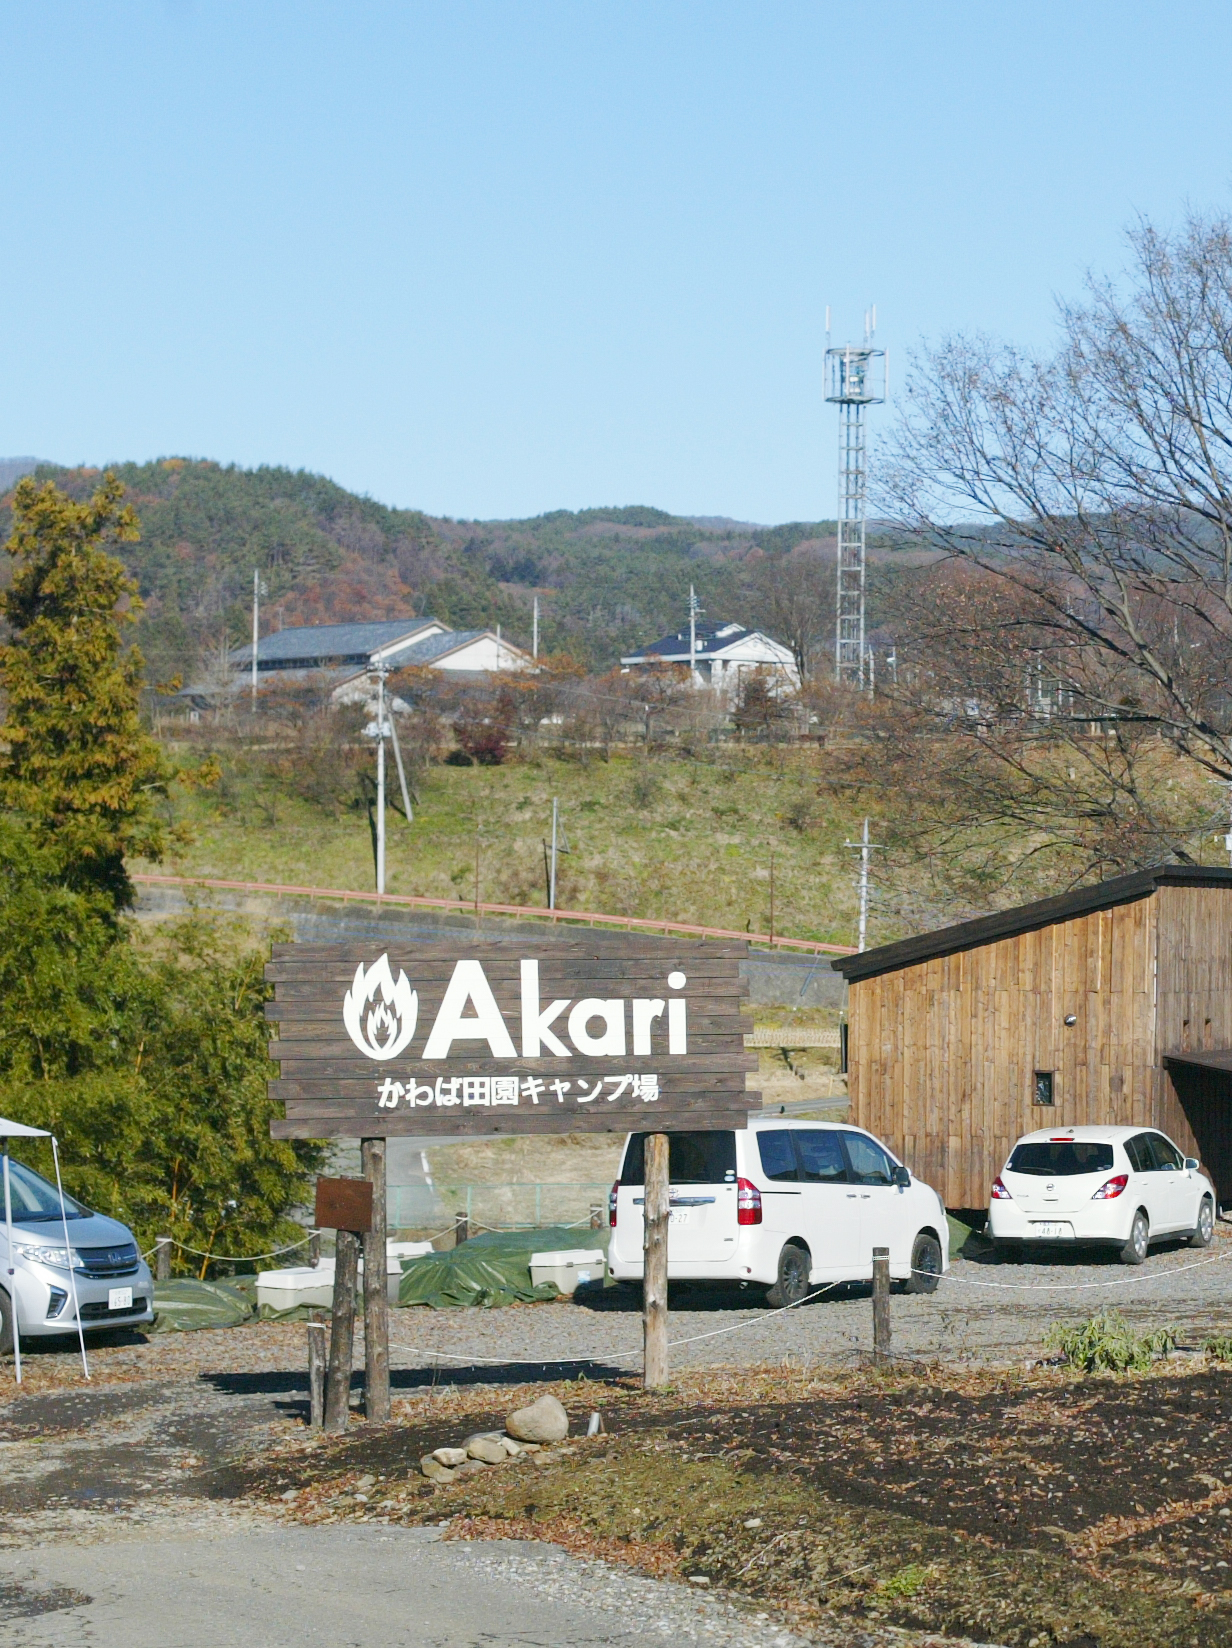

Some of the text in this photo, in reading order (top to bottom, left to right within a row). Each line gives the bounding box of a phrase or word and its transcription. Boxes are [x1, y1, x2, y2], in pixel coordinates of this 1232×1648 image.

[422, 959, 686, 1059] Akari
[378, 1074, 658, 1108] かわば田園キャンプ場
